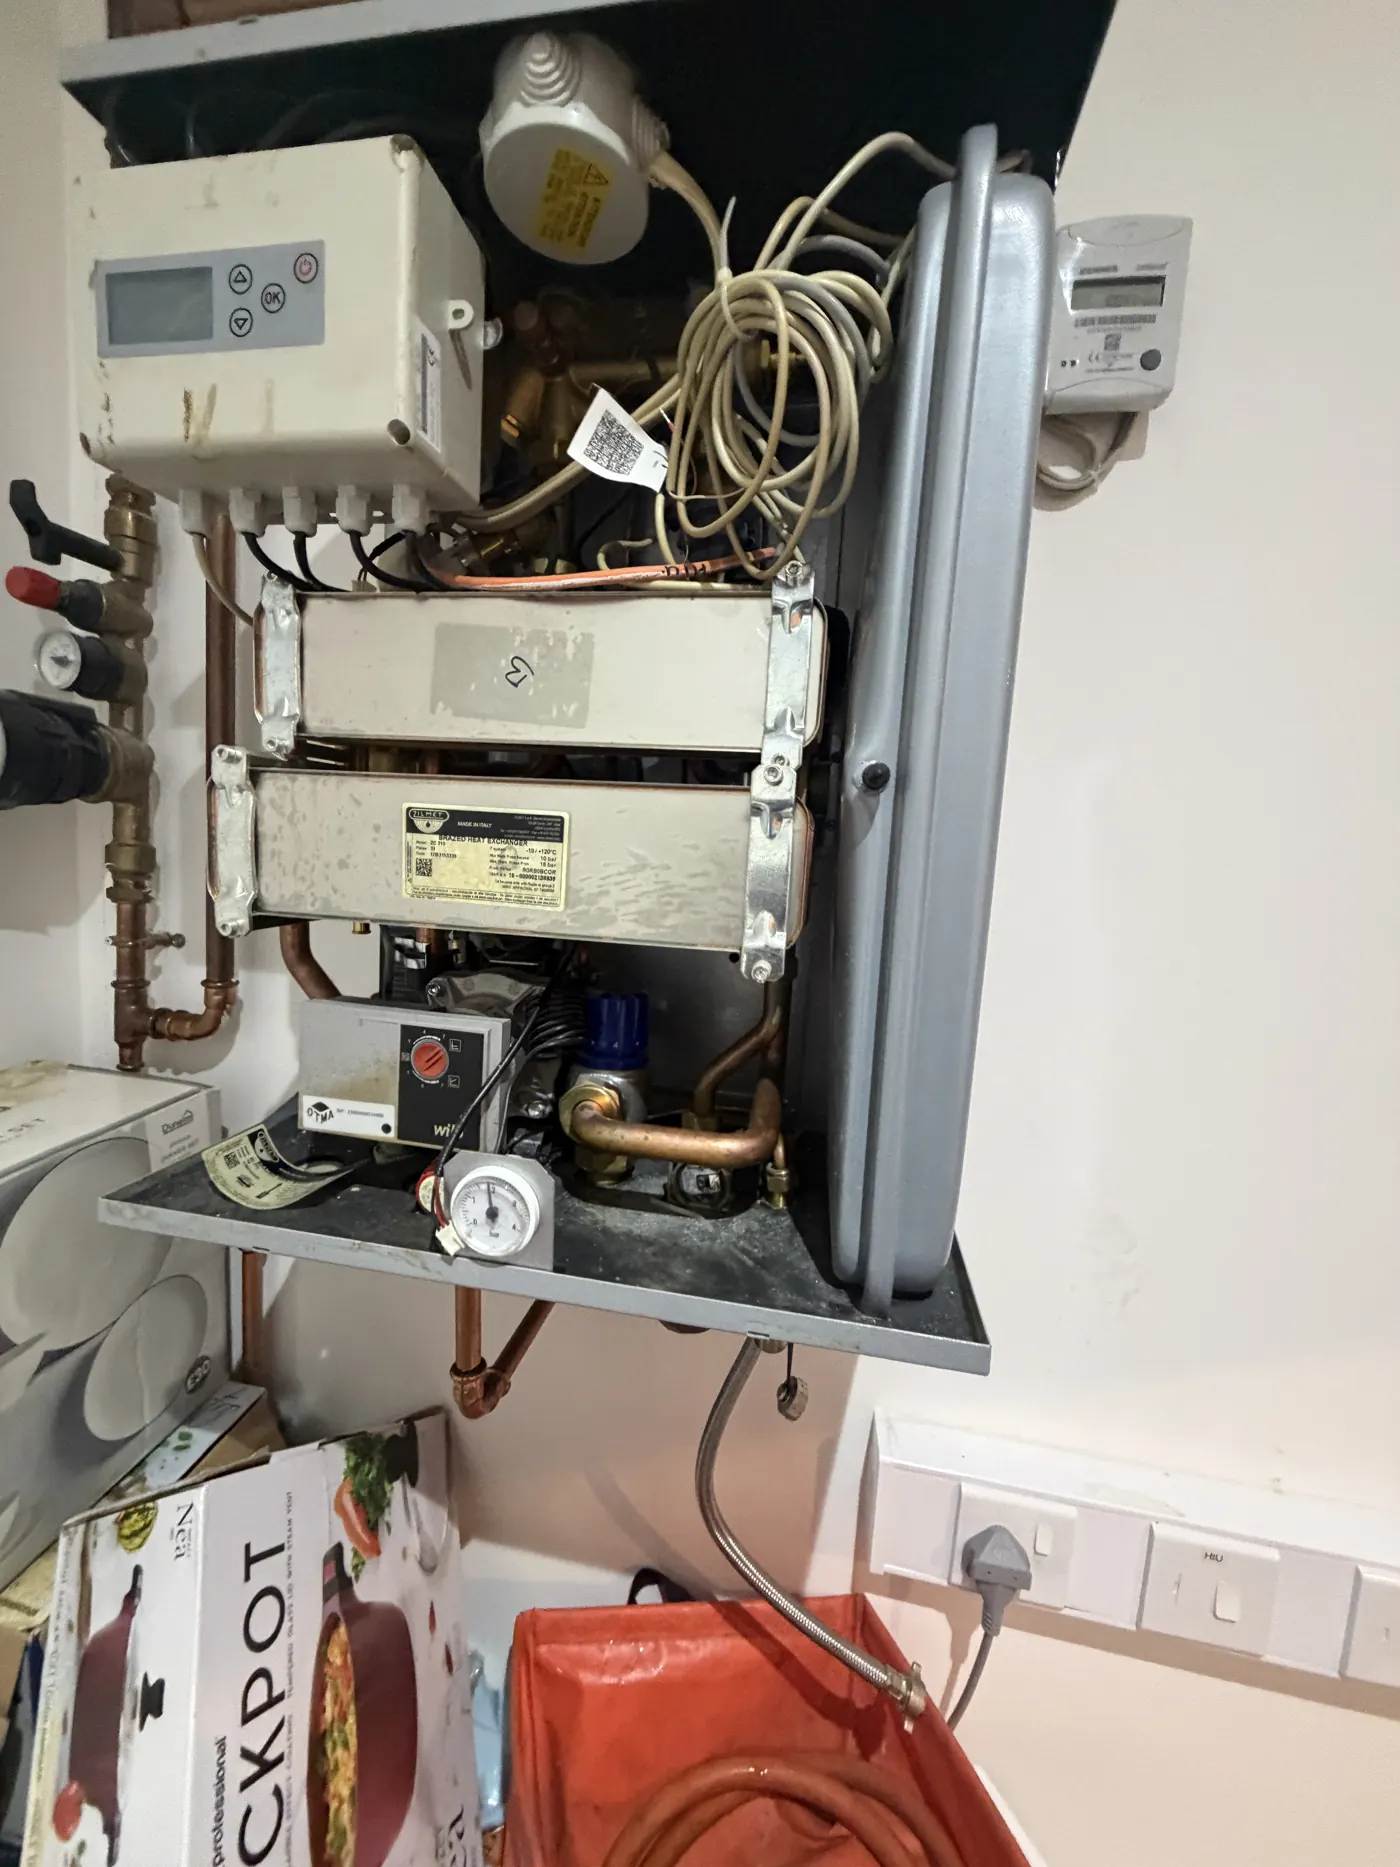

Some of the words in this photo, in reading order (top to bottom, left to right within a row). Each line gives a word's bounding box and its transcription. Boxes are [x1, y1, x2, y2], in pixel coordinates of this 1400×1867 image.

[265, 291, 281, 305] OK
[412, 810, 444, 819] ZILMET
[487, 838, 528, 847] EXCHANGER
[433, 1123, 464, 1139] wil
[174, 1500, 194, 1561] Nea
[1204, 1551, 1224, 1563] HIU
